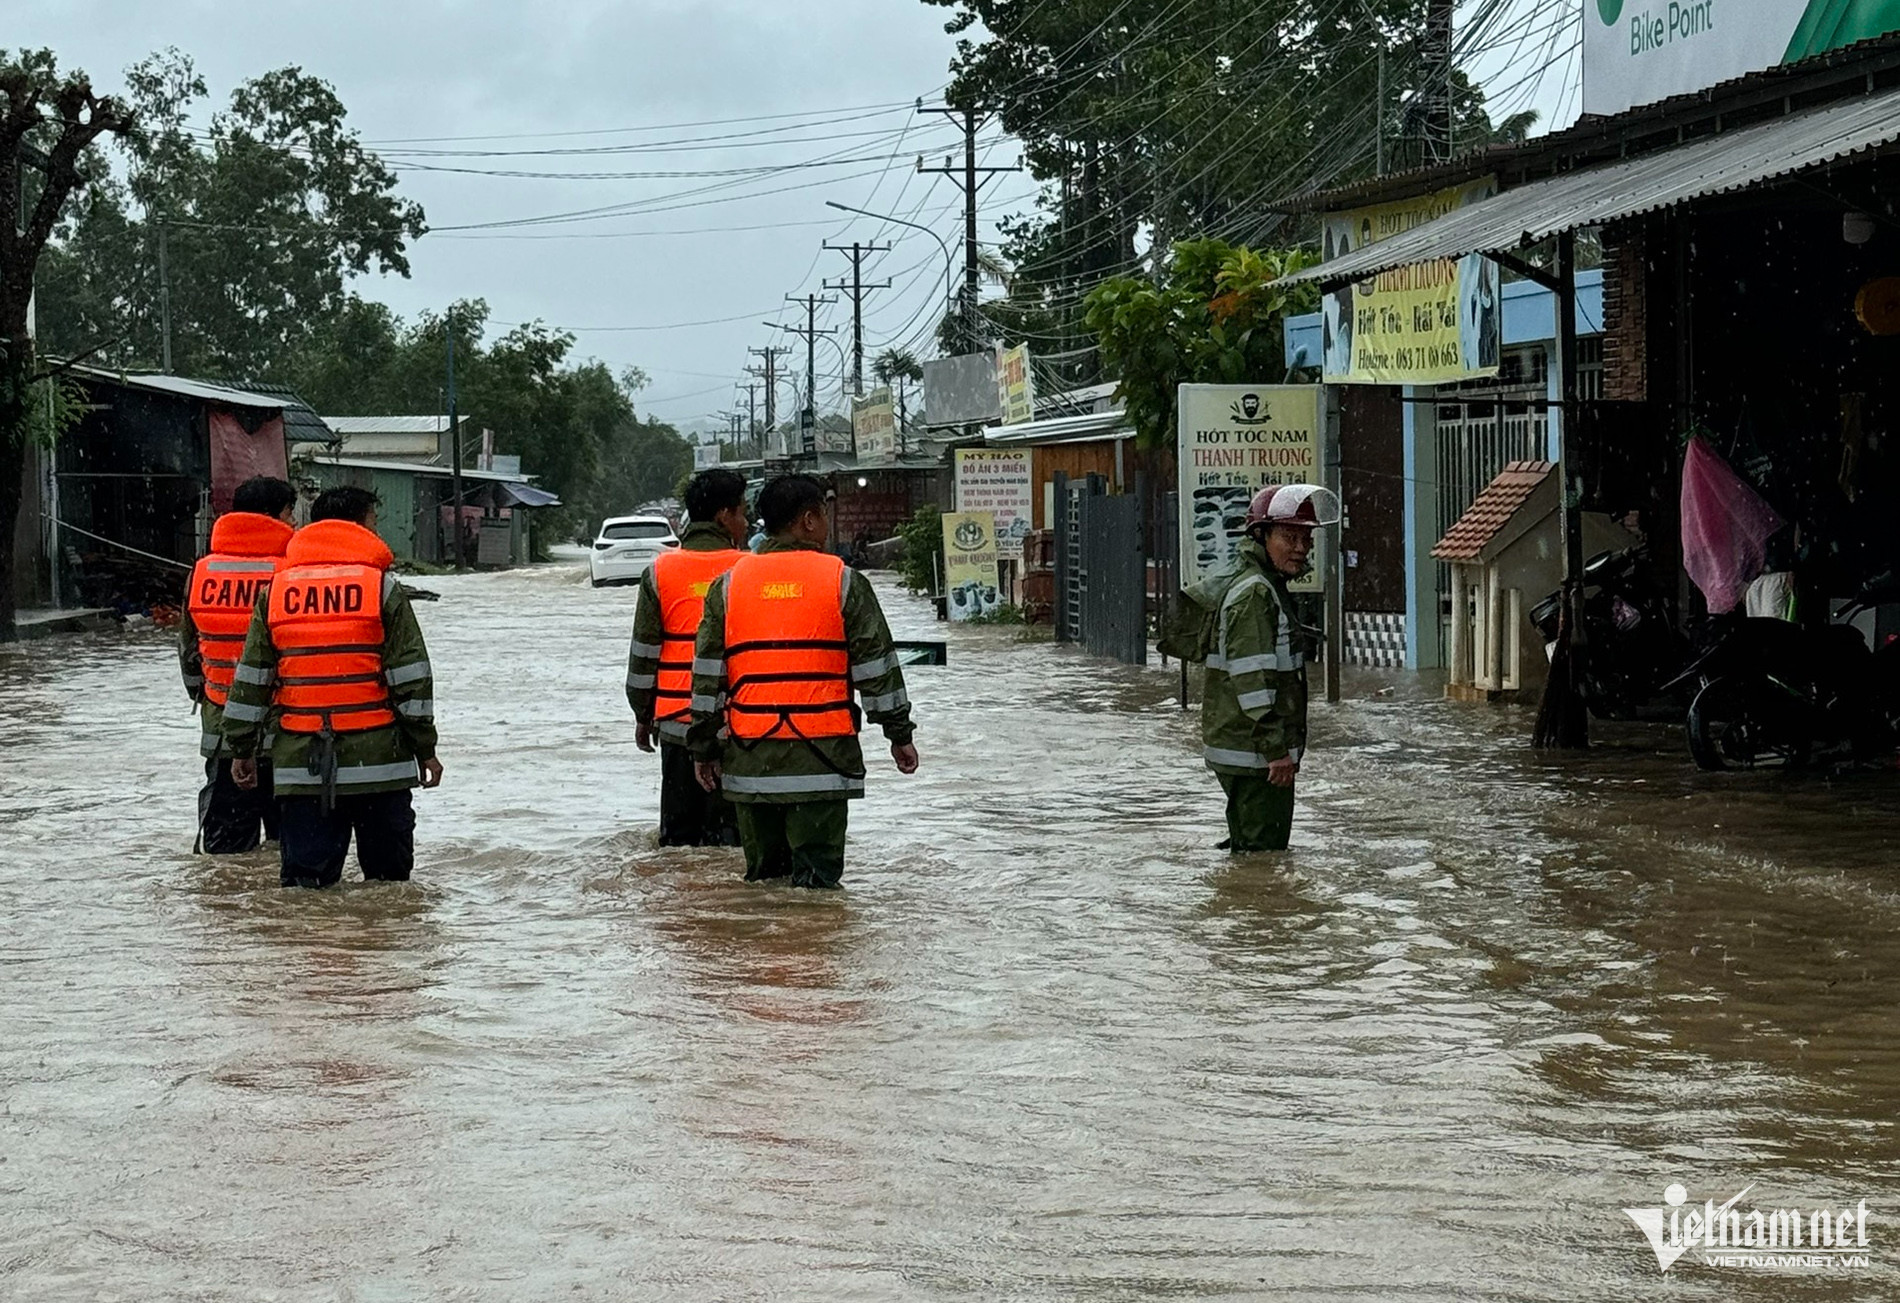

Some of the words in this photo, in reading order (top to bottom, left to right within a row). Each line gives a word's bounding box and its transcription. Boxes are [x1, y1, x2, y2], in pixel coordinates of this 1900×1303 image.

[1631, 10, 1664, 56] Bike
[1669, 0, 1712, 43] Point
[1441, 341, 1459, 366] 663
[1271, 430, 1309, 443] NAM
[1192, 448, 1245, 467] THANH
[993, 464, 1000, 474] 3
[284, 584, 363, 614] CAND
